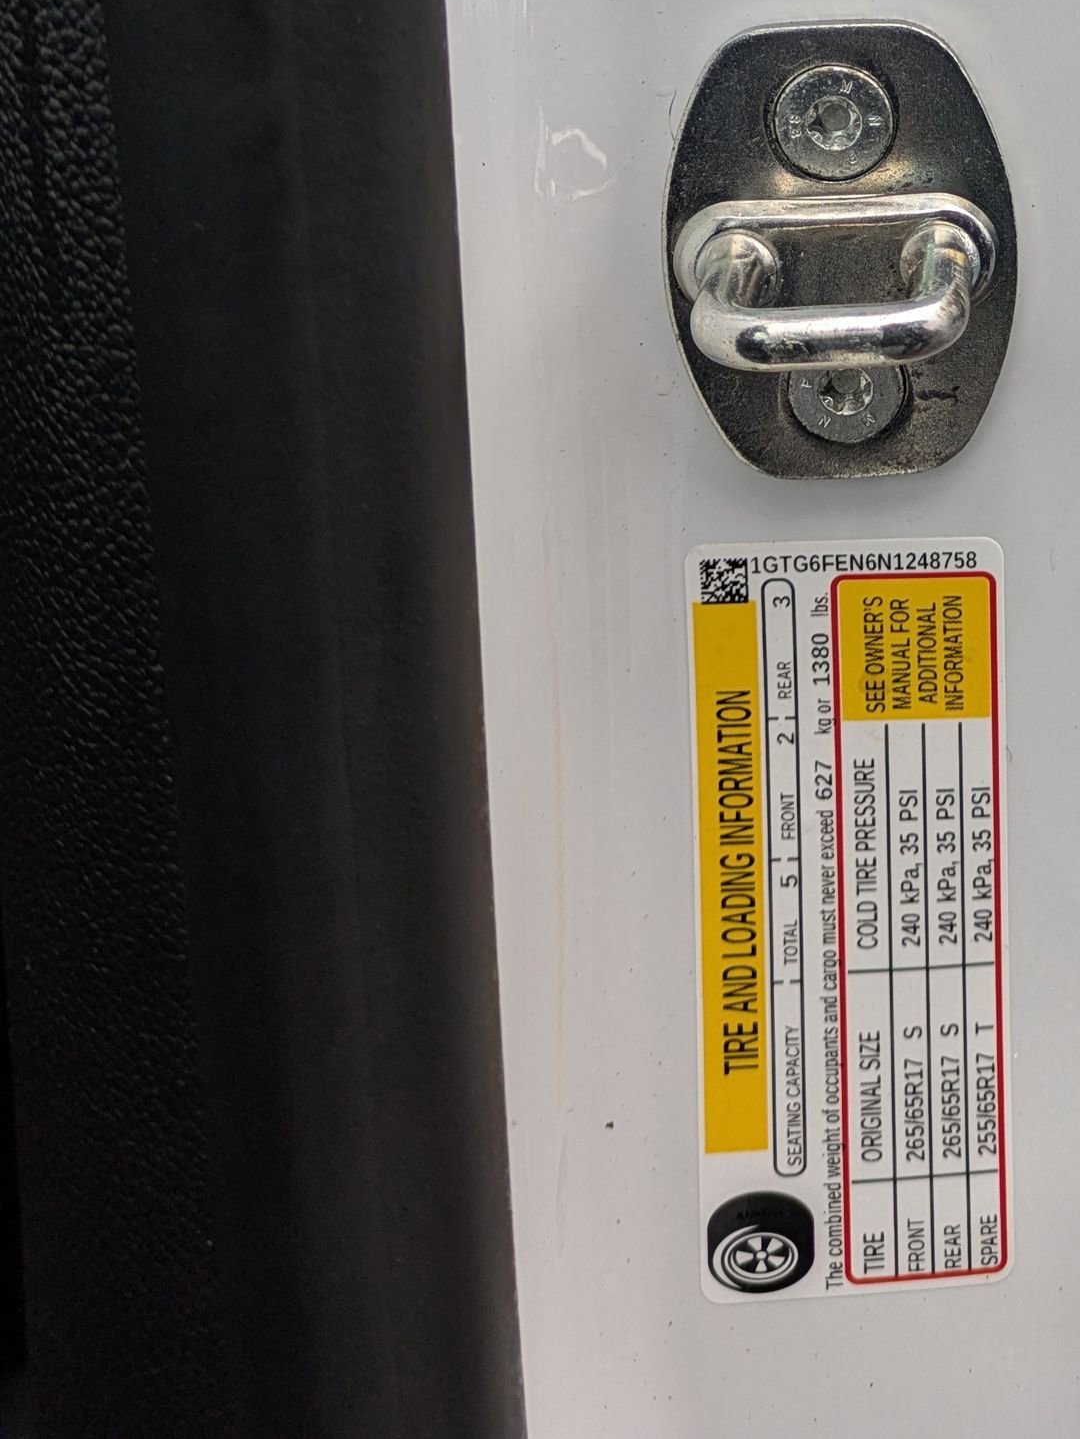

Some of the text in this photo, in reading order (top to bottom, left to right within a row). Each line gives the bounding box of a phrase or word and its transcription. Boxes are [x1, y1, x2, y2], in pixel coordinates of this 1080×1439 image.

[751, 551, 979, 576] 1GTG6FEN6N1248758
[863, 596, 885, 713] SEE OWNER'S
[889, 599, 911, 709] MANUAL FOR
[916, 602, 938, 704] ADDITIONAL
[942, 596, 964, 711] INFORMATION
[716, 690, 759, 1076] TIRE AND LOADING INFORMATION
[772, 593, 804, 1167] SEATING CAPACITY TOTAL 5 FRONT 2 REAR 3
[811, 593, 845, 1290] The combined weight of occupants and cargo must never exceed 627 kg or 1380 lbs.
[853, 758, 885, 1274] TIRE ORIGINAL SIZE COLD TIRE PRESSURE
[899, 790, 925, 1272] FRONT 265/65R17 S 240 kPa, 35 PSI
[936, 788, 963, 1271] REAR 265/65R17 S 240 kPa, 35 PSI
[971, 787, 999, 1267] SPARE 255/65R17 T 240 kPa, 35 PSI
